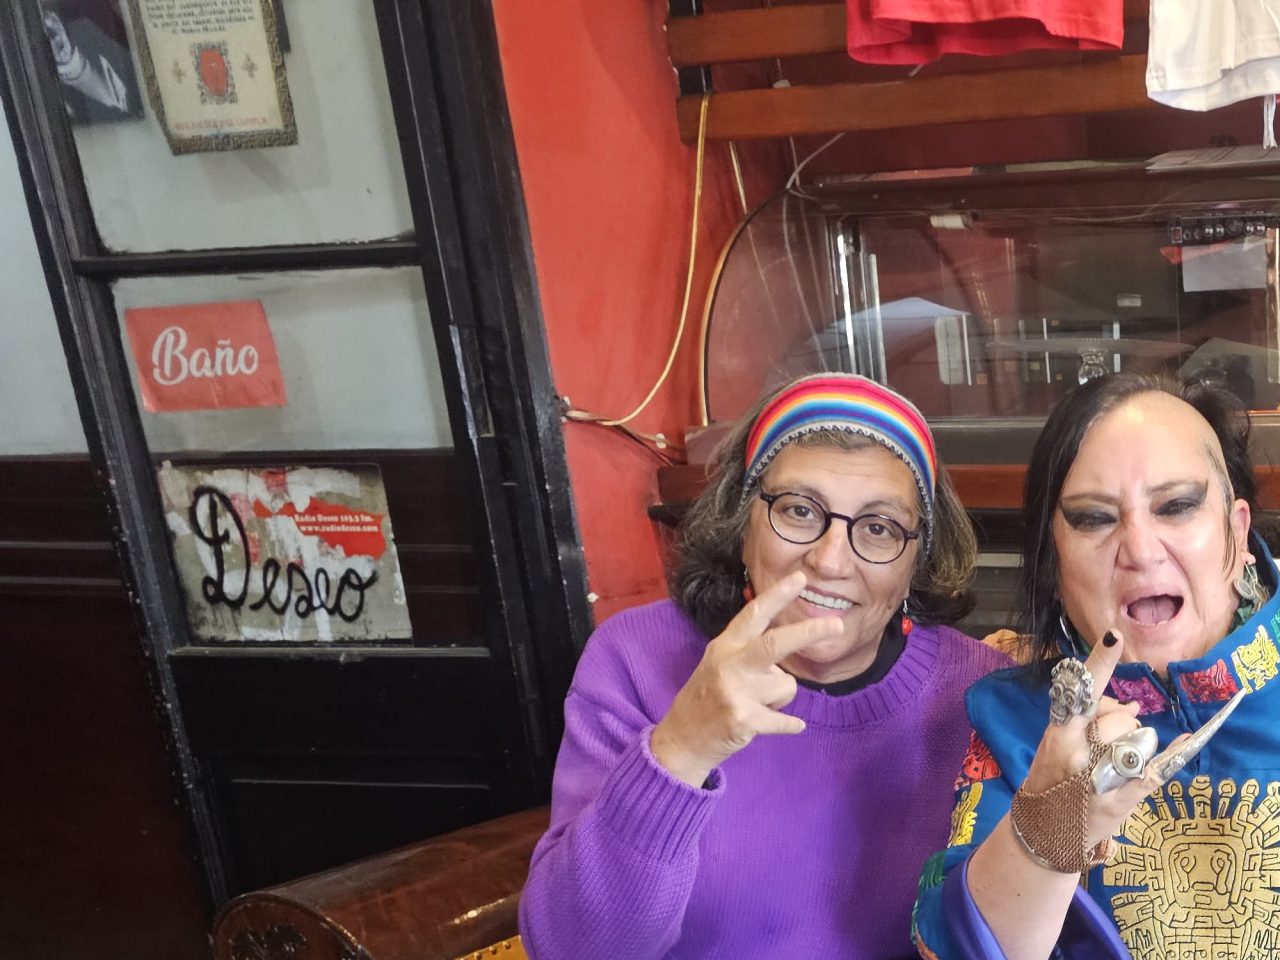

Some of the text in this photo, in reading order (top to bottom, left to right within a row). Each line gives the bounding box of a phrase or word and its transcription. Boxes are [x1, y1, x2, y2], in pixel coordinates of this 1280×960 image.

[152, 326, 259, 386] Baño
[294, 514, 317, 523] Radio
[317, 514, 339, 522] Deseo
[300, 524, 379, 533] www.radiodeseo.com
[189, 485, 379, 623] Deseo
